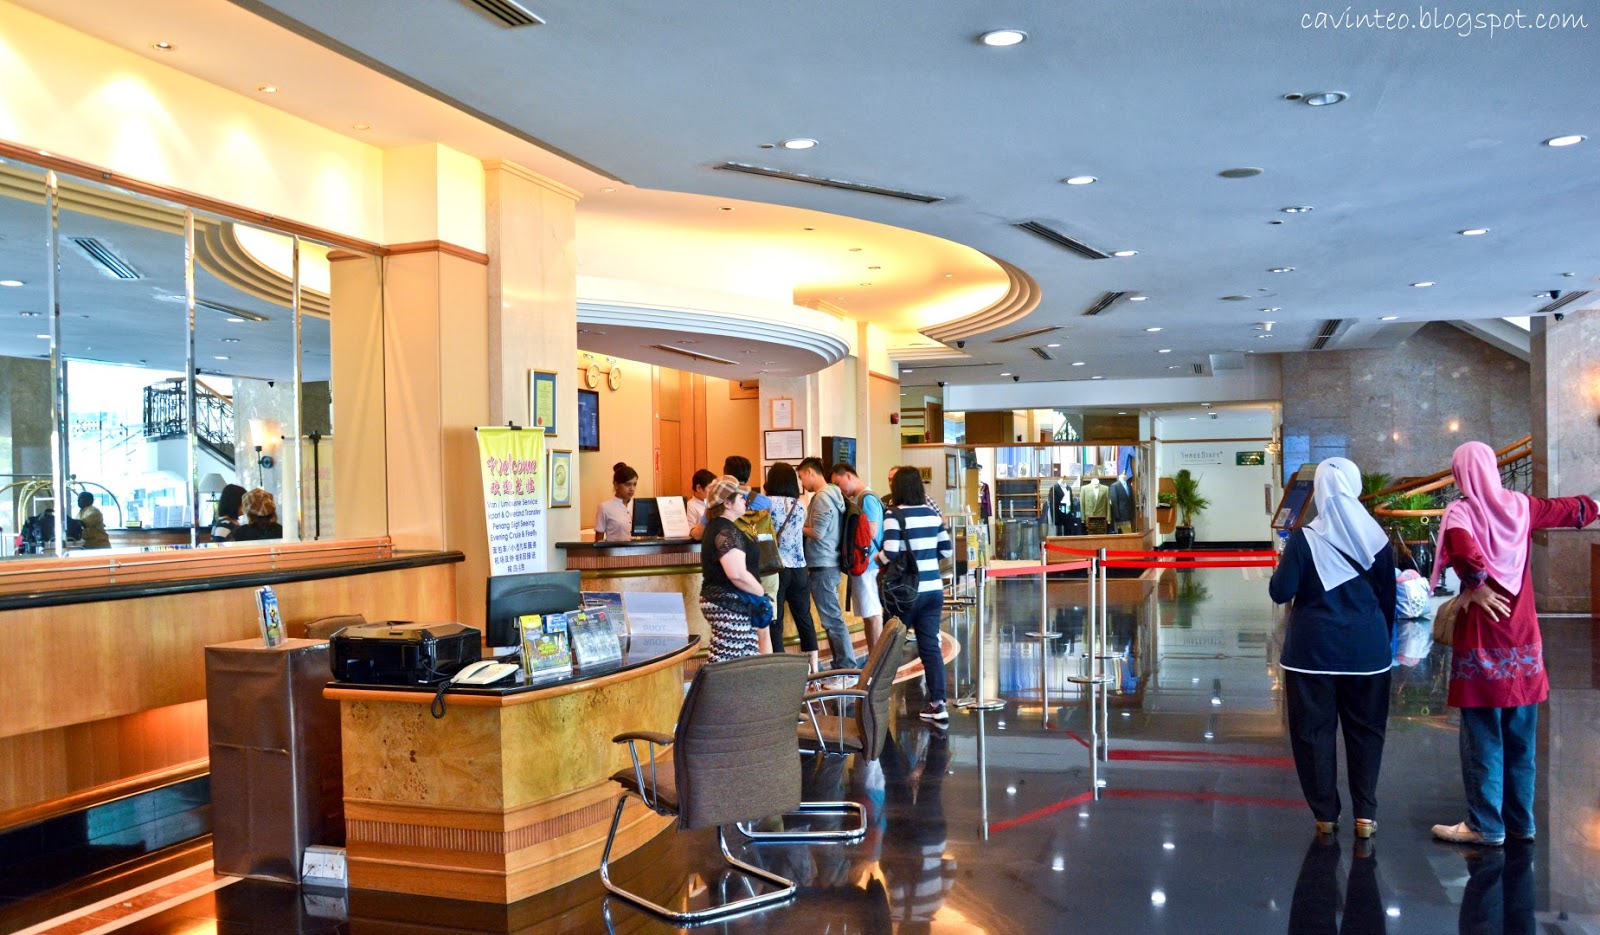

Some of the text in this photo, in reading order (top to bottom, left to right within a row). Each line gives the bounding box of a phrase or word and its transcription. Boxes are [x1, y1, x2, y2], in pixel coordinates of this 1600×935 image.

[486, 453, 538, 477] Welcome
[522, 498, 538, 506] Service
[492, 522, 511, 531] Penang
[521, 519, 536, 528] Seeing
[490, 533, 509, 542] Evening
